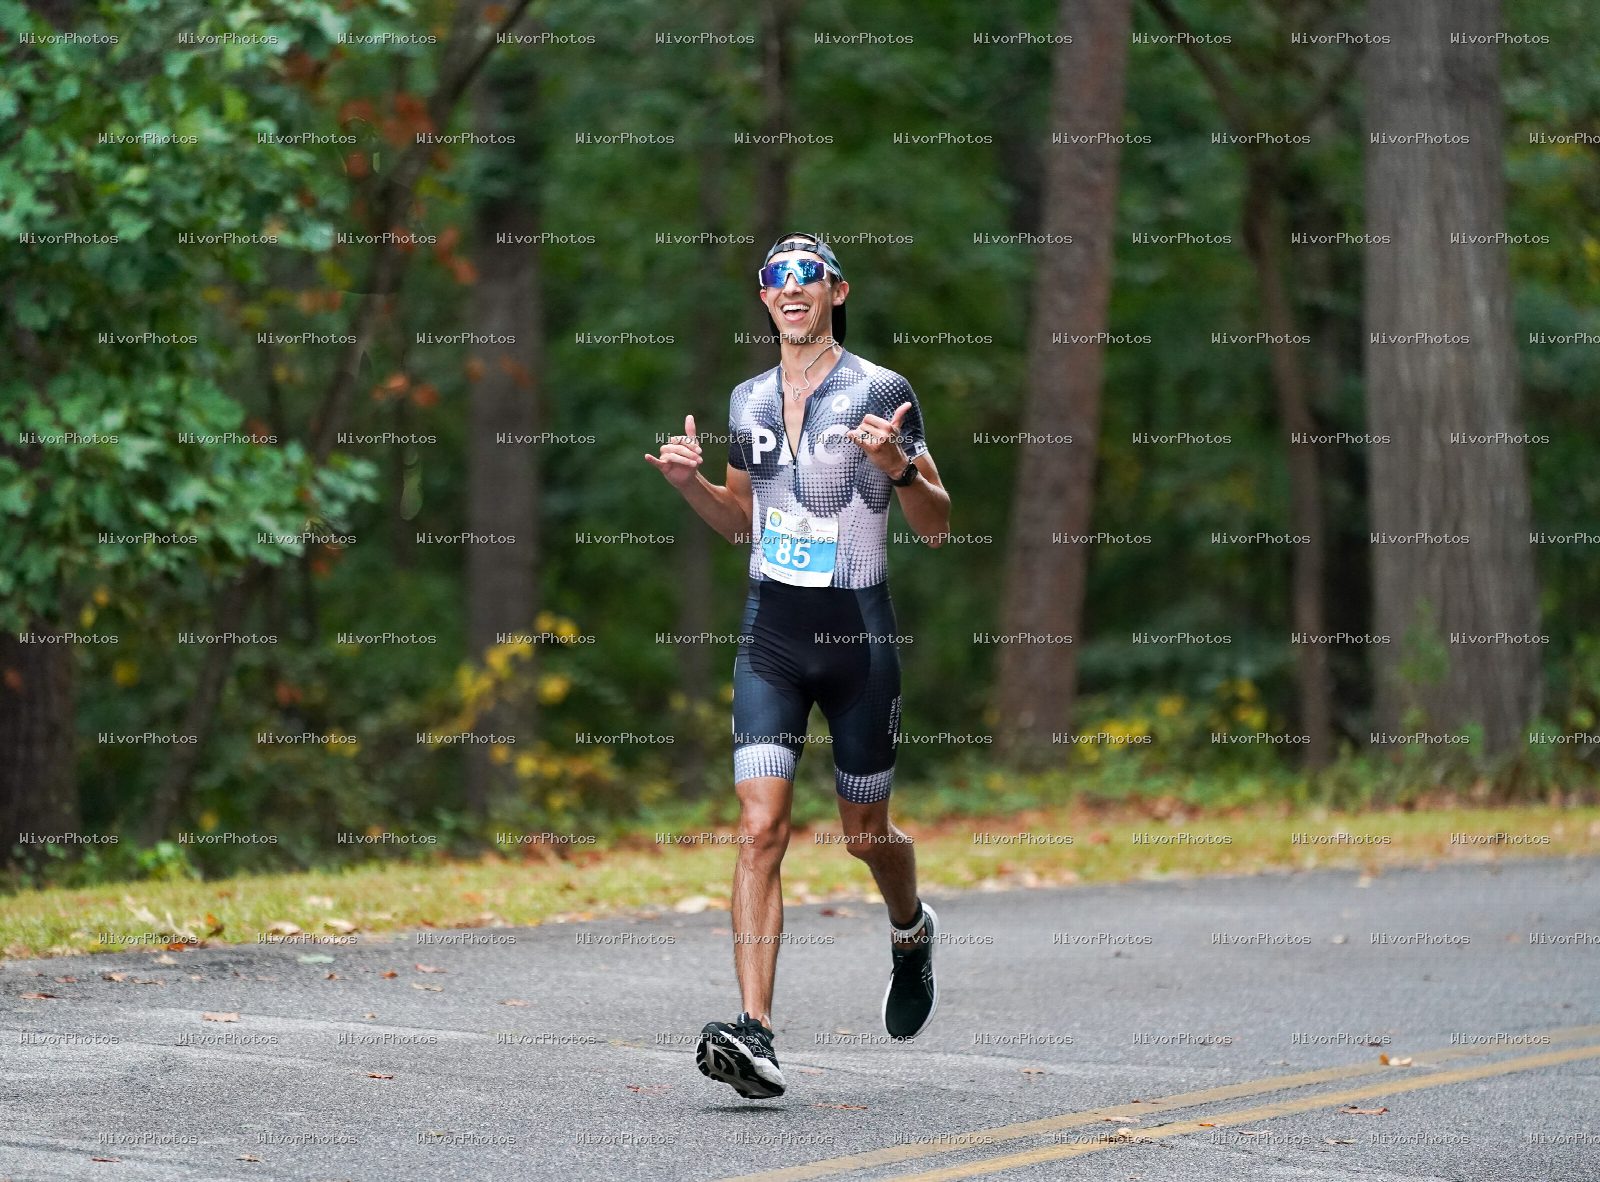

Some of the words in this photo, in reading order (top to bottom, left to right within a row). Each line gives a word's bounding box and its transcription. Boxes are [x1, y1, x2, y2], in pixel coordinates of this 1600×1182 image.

[751, 424, 850, 465] PAC
[775, 536, 811, 569] 85
[887, 698, 896, 734] PACTIMO
